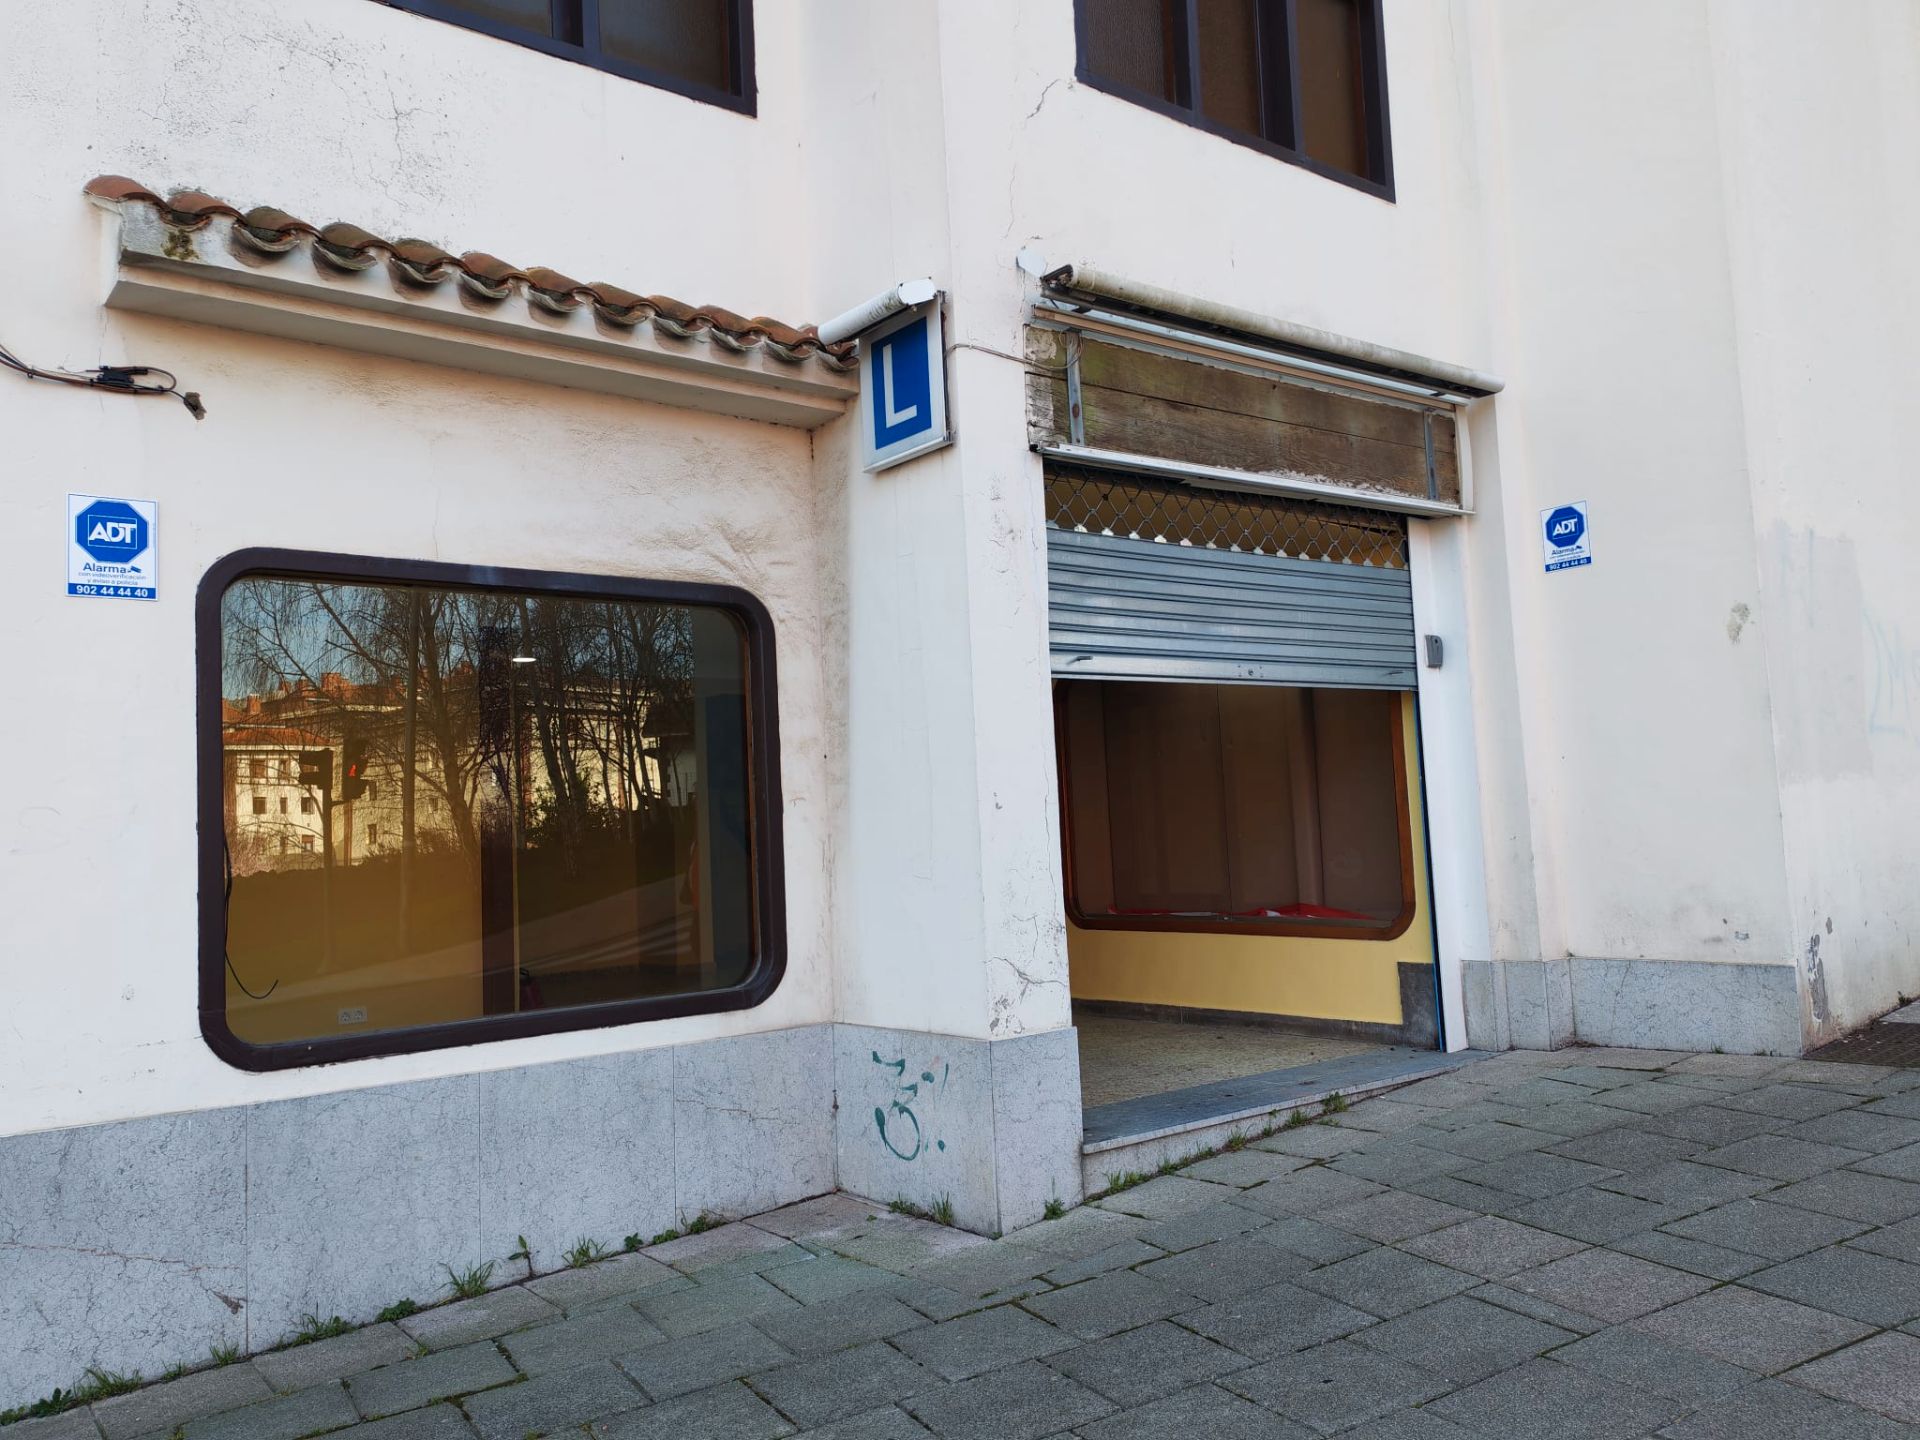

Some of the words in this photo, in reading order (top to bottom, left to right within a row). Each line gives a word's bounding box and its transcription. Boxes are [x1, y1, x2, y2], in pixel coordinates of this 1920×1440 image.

[882, 343, 918, 429] L
[88, 521, 137, 544] ADT
[1552, 518, 1578, 536] ADT
[83, 562, 127, 574] Alarma
[76, 585, 97, 595] 902
[100, 586, 114, 596] 44
[117, 587, 131, 597] 44
[134, 588, 148, 597] 40
